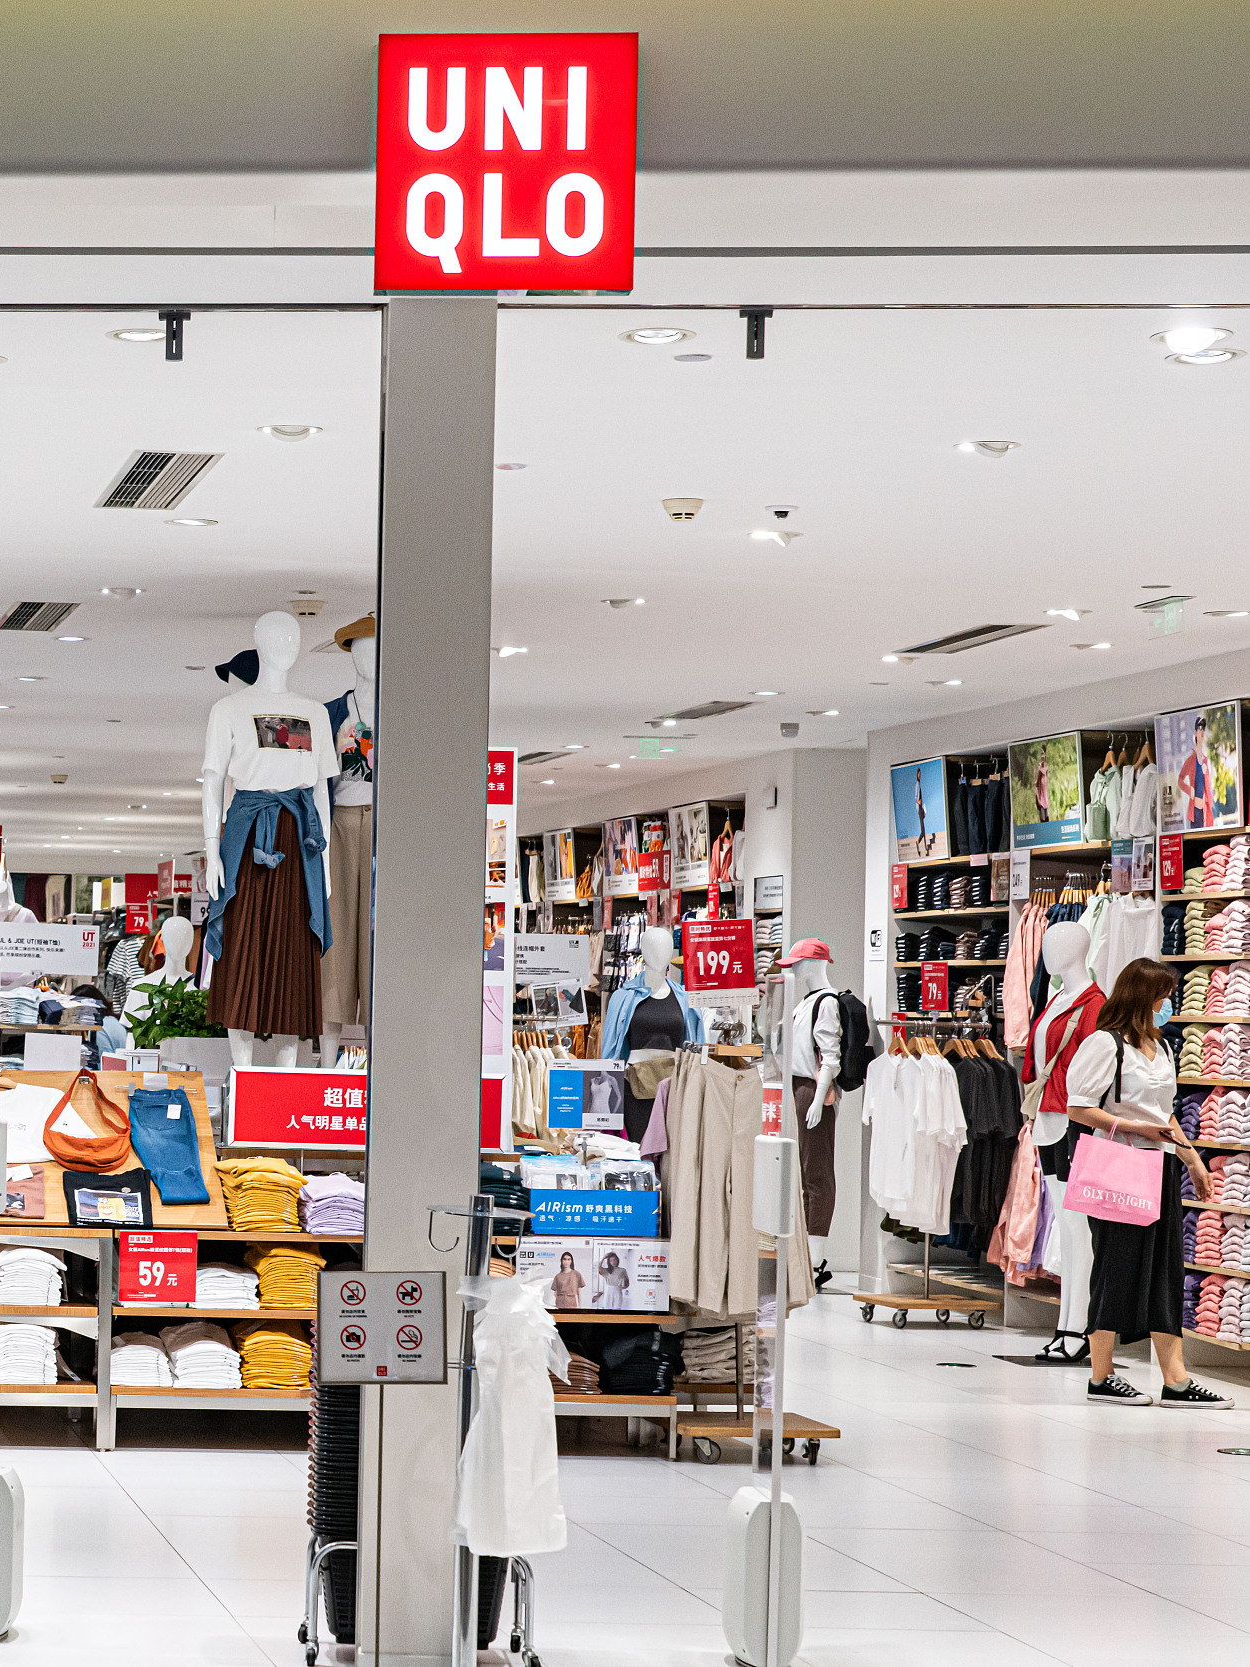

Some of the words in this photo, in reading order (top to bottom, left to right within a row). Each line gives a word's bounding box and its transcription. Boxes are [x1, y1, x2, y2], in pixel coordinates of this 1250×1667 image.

[408, 66, 587, 150] UNI
[406, 173, 604, 273] QLO
[134, 917, 144, 927] 79
[82, 932, 95, 941] UT
[697, 951, 730, 975] 199
[733, 962, 742, 973] 元
[928, 983, 937, 1000] 79
[323, 1087, 367, 1108] 超值
[535, 1202, 583, 1212] AIRism
[586, 1205, 632, 1214] 舒爽黑科技
[1083, 1186, 1152, 1210] 6IXTY8IGHT
[139, 1261, 165, 1286] 59
[167, 1274, 177, 1286] 元
